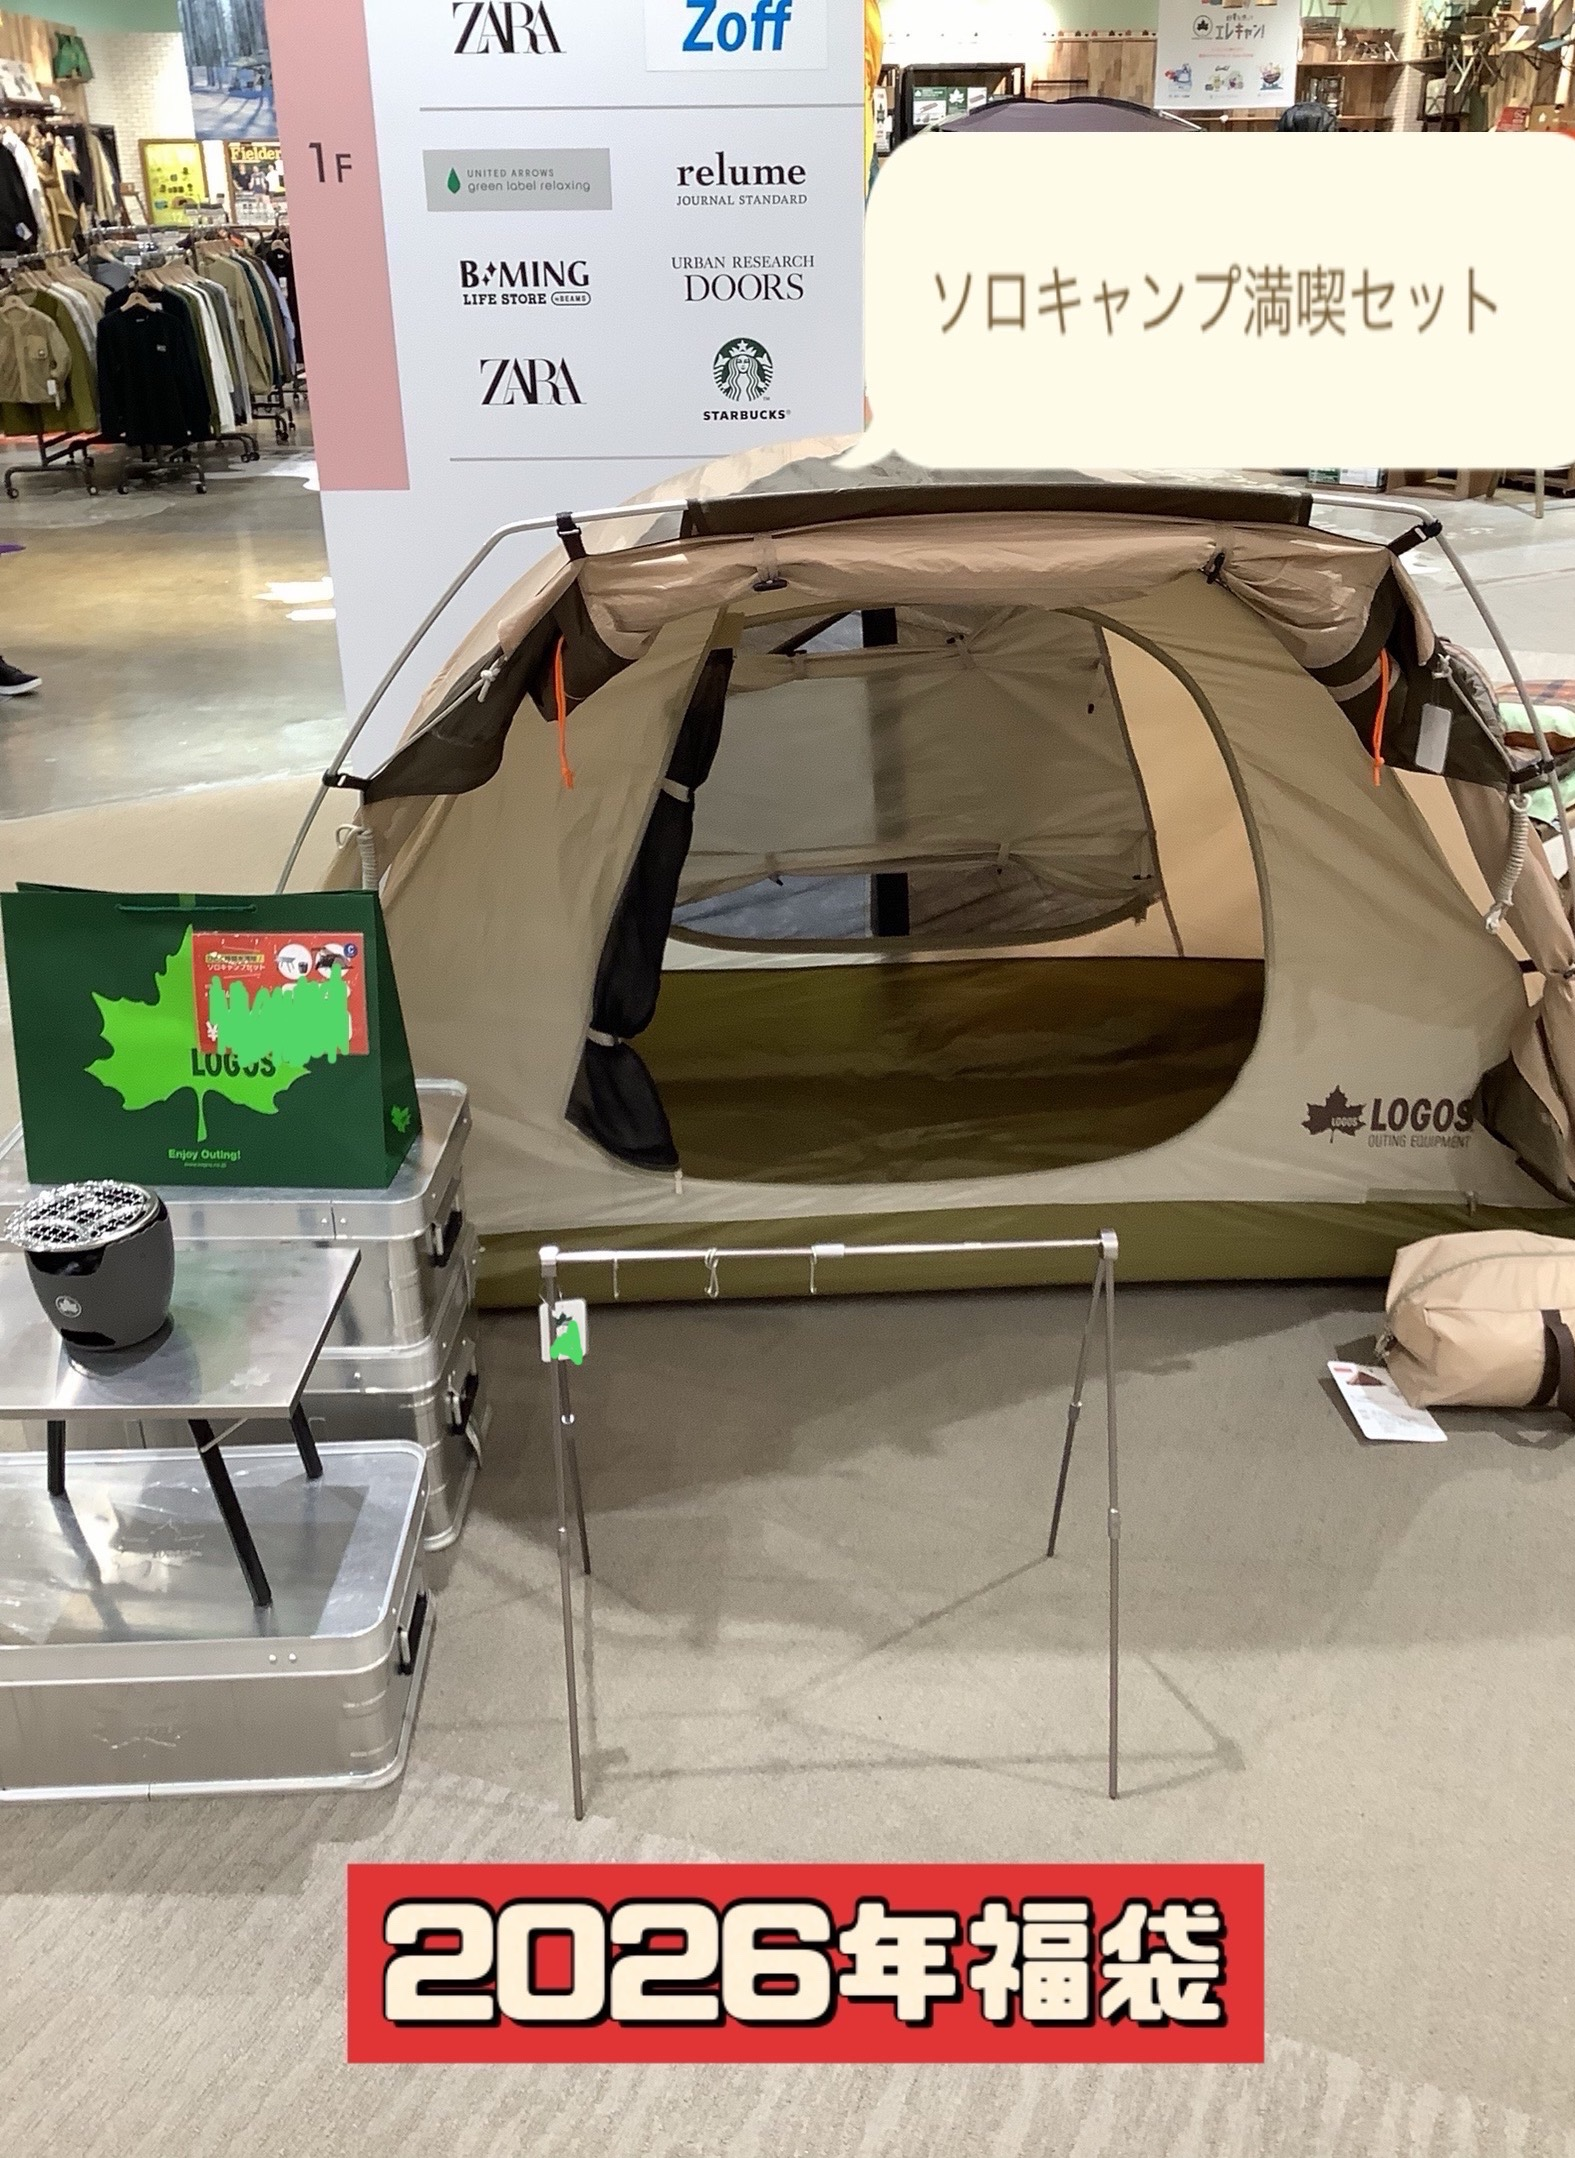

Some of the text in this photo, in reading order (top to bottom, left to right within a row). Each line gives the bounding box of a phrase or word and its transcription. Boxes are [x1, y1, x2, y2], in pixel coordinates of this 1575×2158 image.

[452, 0, 567, 54] ZARA
[682, 0, 792, 52] Zoff
[231, 146, 282, 161] Fielder
[467, 168, 554, 178] UNITED ARROWS
[676, 151, 806, 187] relume
[467, 180, 591, 193] green label relaxing
[676, 194, 808, 206] JOURNAL STANDARD
[671, 255, 815, 270] URBAN RESEARCH
[684, 273, 804, 301] DOORS
[463, 294, 497, 305] LIFE
[502, 293, 547, 304] STORE
[480, 357, 587, 405] ZARA
[1370, 1097, 1474, 1132] LOGOS
[1368, 1134, 1472, 1149] OUTING EQUIPMENT
[168, 1149, 241, 1161] Enjoy Outing!
